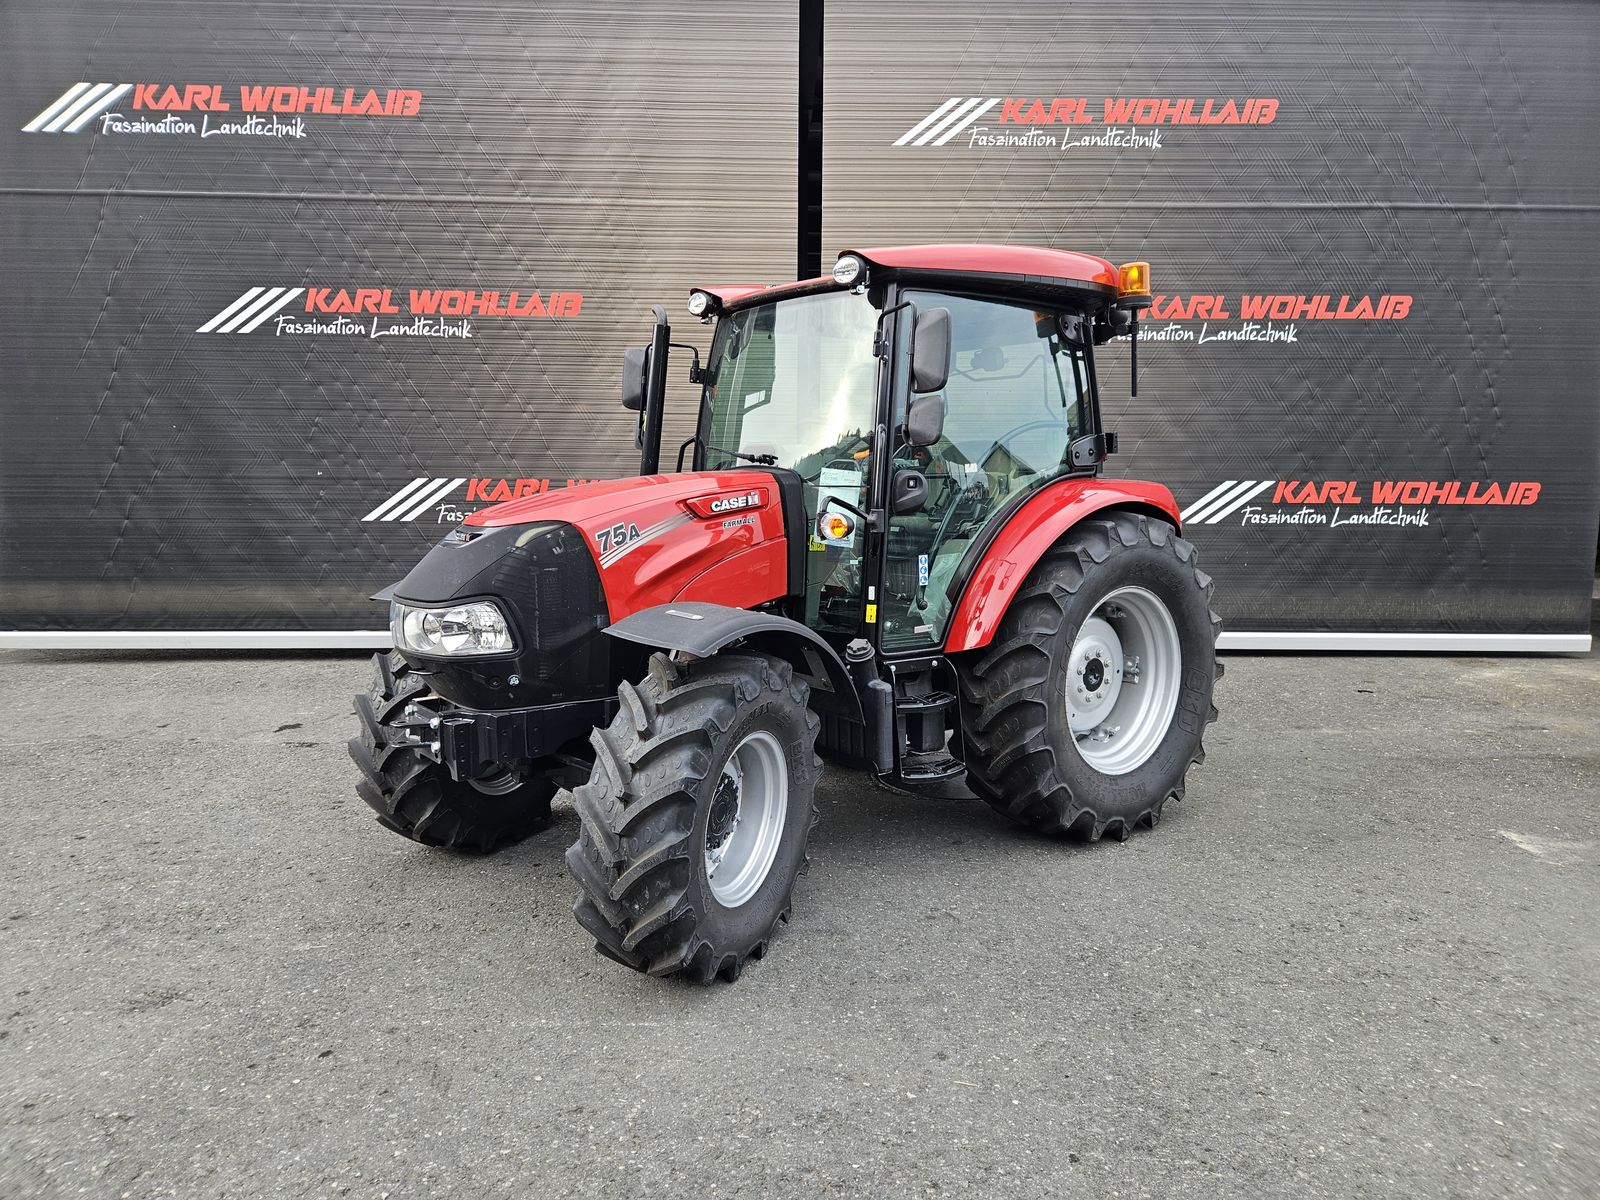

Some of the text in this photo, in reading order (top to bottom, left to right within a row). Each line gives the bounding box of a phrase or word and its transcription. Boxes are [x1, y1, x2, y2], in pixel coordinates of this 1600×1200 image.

[133, 83, 230, 112] KARL
[1000, 97, 1093, 125] KARL
[100, 112, 307, 139] Faszination Landtechnik
[968, 126, 1163, 150] Faszination Landtechnik
[305, 287, 400, 314] KARL
[1138, 295, 1231, 320] KARL
[273, 315, 473, 339] Faszination Landtechnik
[1198, 322, 1298, 345] Landtechnik
[711, 496, 747, 512] CASE
[1271, 480, 1362, 505] KARL
[723, 516, 756, 528] FARMALL
[1241, 505, 1430, 528] Faszination Landtechnik
[595, 522, 641, 554] 75A
